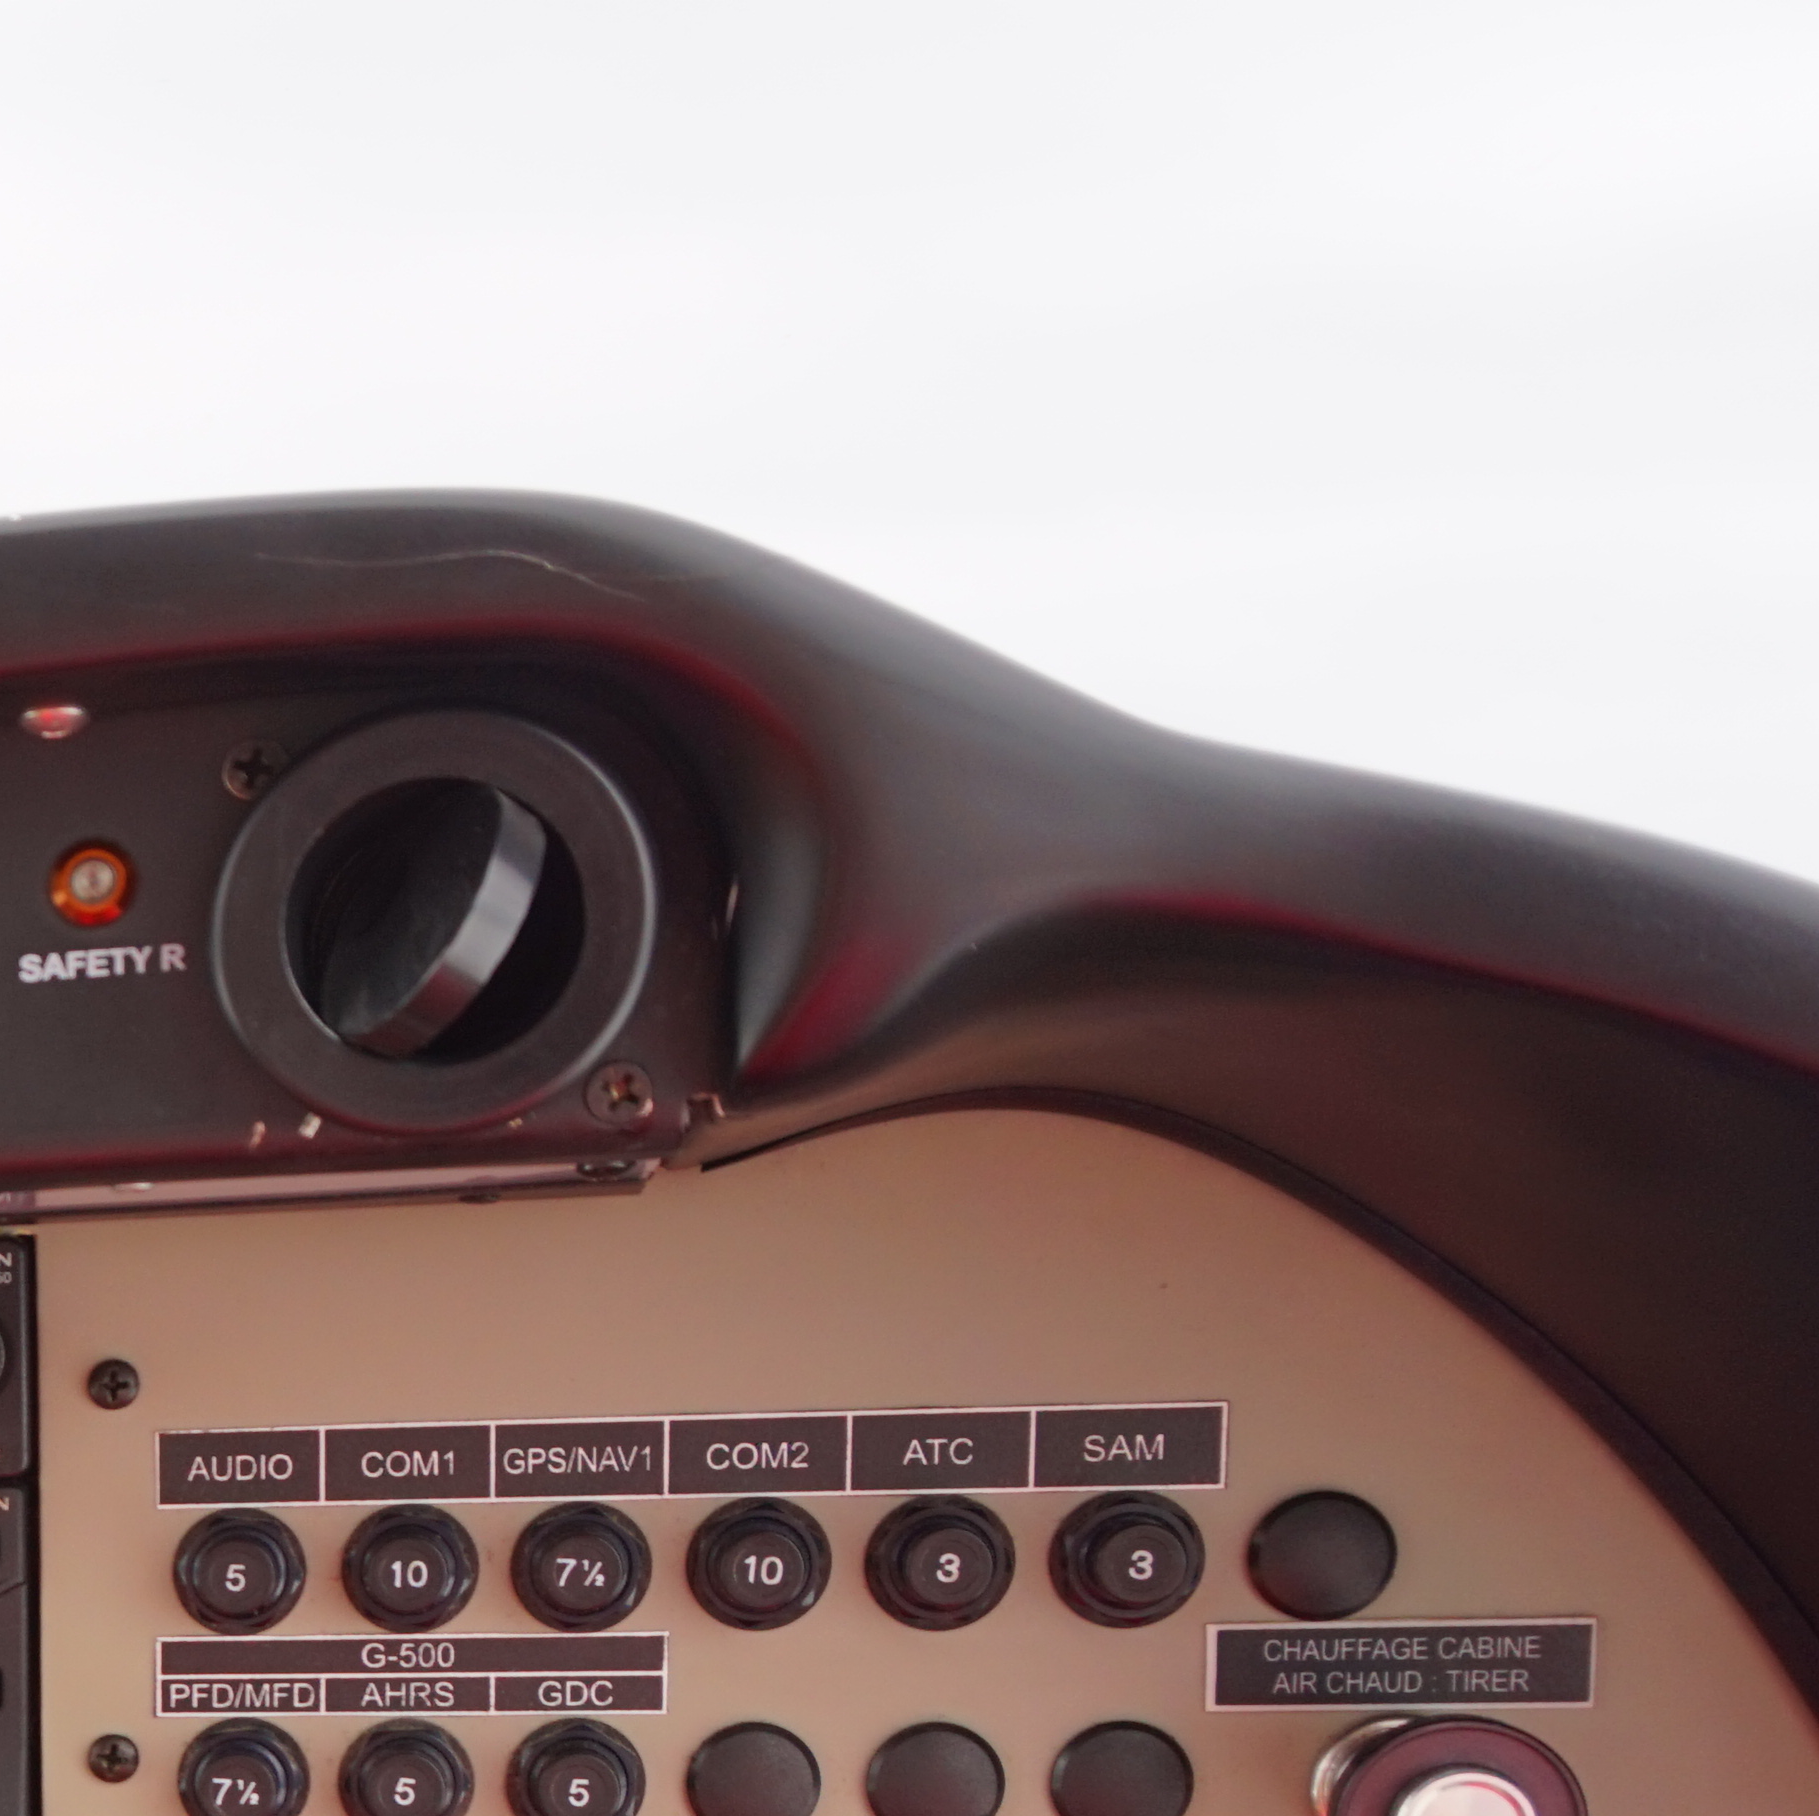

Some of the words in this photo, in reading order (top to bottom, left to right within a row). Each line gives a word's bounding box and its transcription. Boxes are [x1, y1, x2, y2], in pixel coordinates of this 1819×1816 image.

[19, 948, 151, 983] SAFETY
[161, 944, 186, 970] R
[503, 1446, 653, 1474] GPS/NAV1
[706, 1443, 810, 1470] COM2
[903, 1438, 974, 1466] ATC
[1083, 1434, 1165, 1462] SAM
[188, 1454, 293, 1482] AUDIO
[361, 1451, 456, 1477] COM1
[361, 1643, 456, 1669] G-500
[1264, 1637, 1428, 1662] CHAUFFAGE
[1439, 1636, 1541, 1660] CABINE
[361, 1682, 455, 1707] AHRS
[538, 1680, 614, 1707] GDC
[1273, 1672, 1317, 1694] AIR
[1326, 1671, 1422, 1694] CHAUD
[1446, 1670, 1529, 1692] TIRER
[169, 1683, 315, 1709] PFD/MFD
